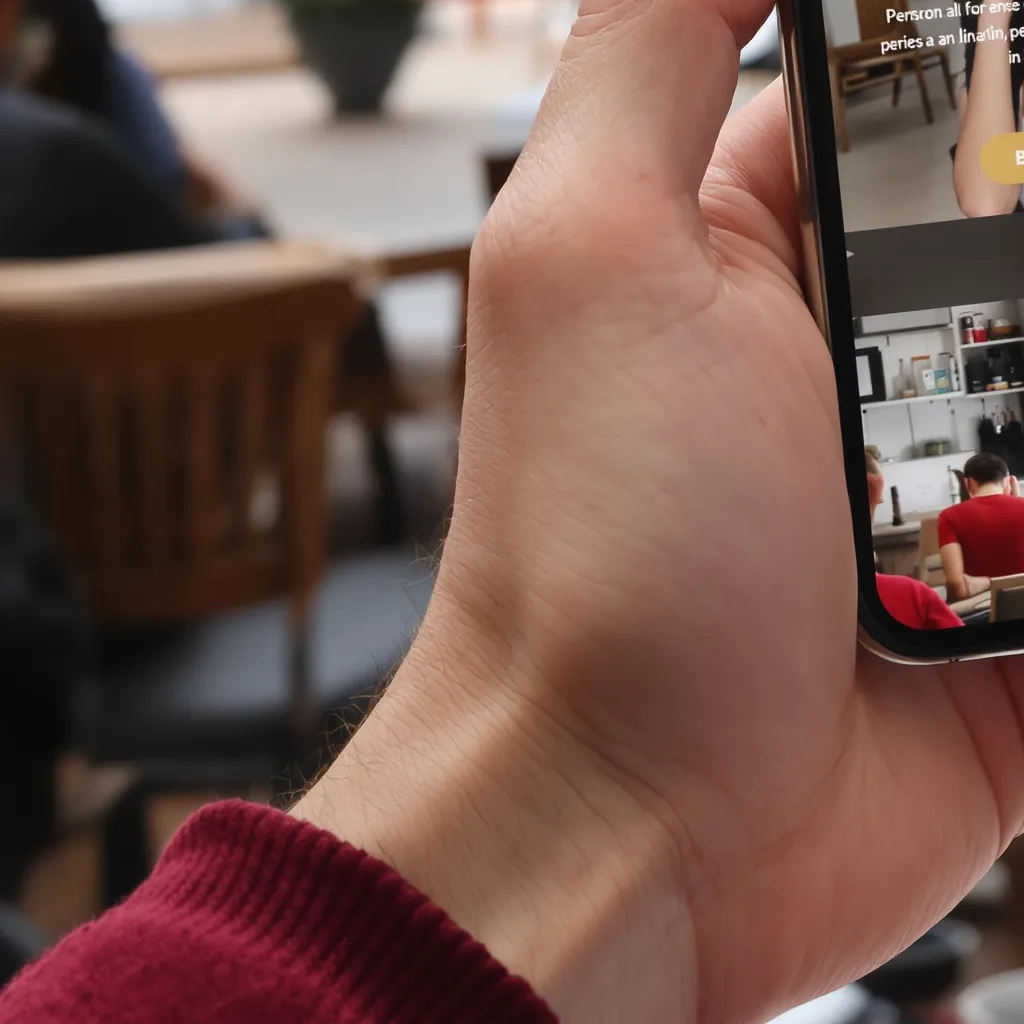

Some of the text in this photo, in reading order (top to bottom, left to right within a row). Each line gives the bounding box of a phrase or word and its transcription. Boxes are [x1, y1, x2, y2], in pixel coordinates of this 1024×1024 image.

[946, 2, 961, 18] all
[964, 1, 986, 16] for
[938, 34, 956, 46] an
[1008, 50, 1021, 64] in
